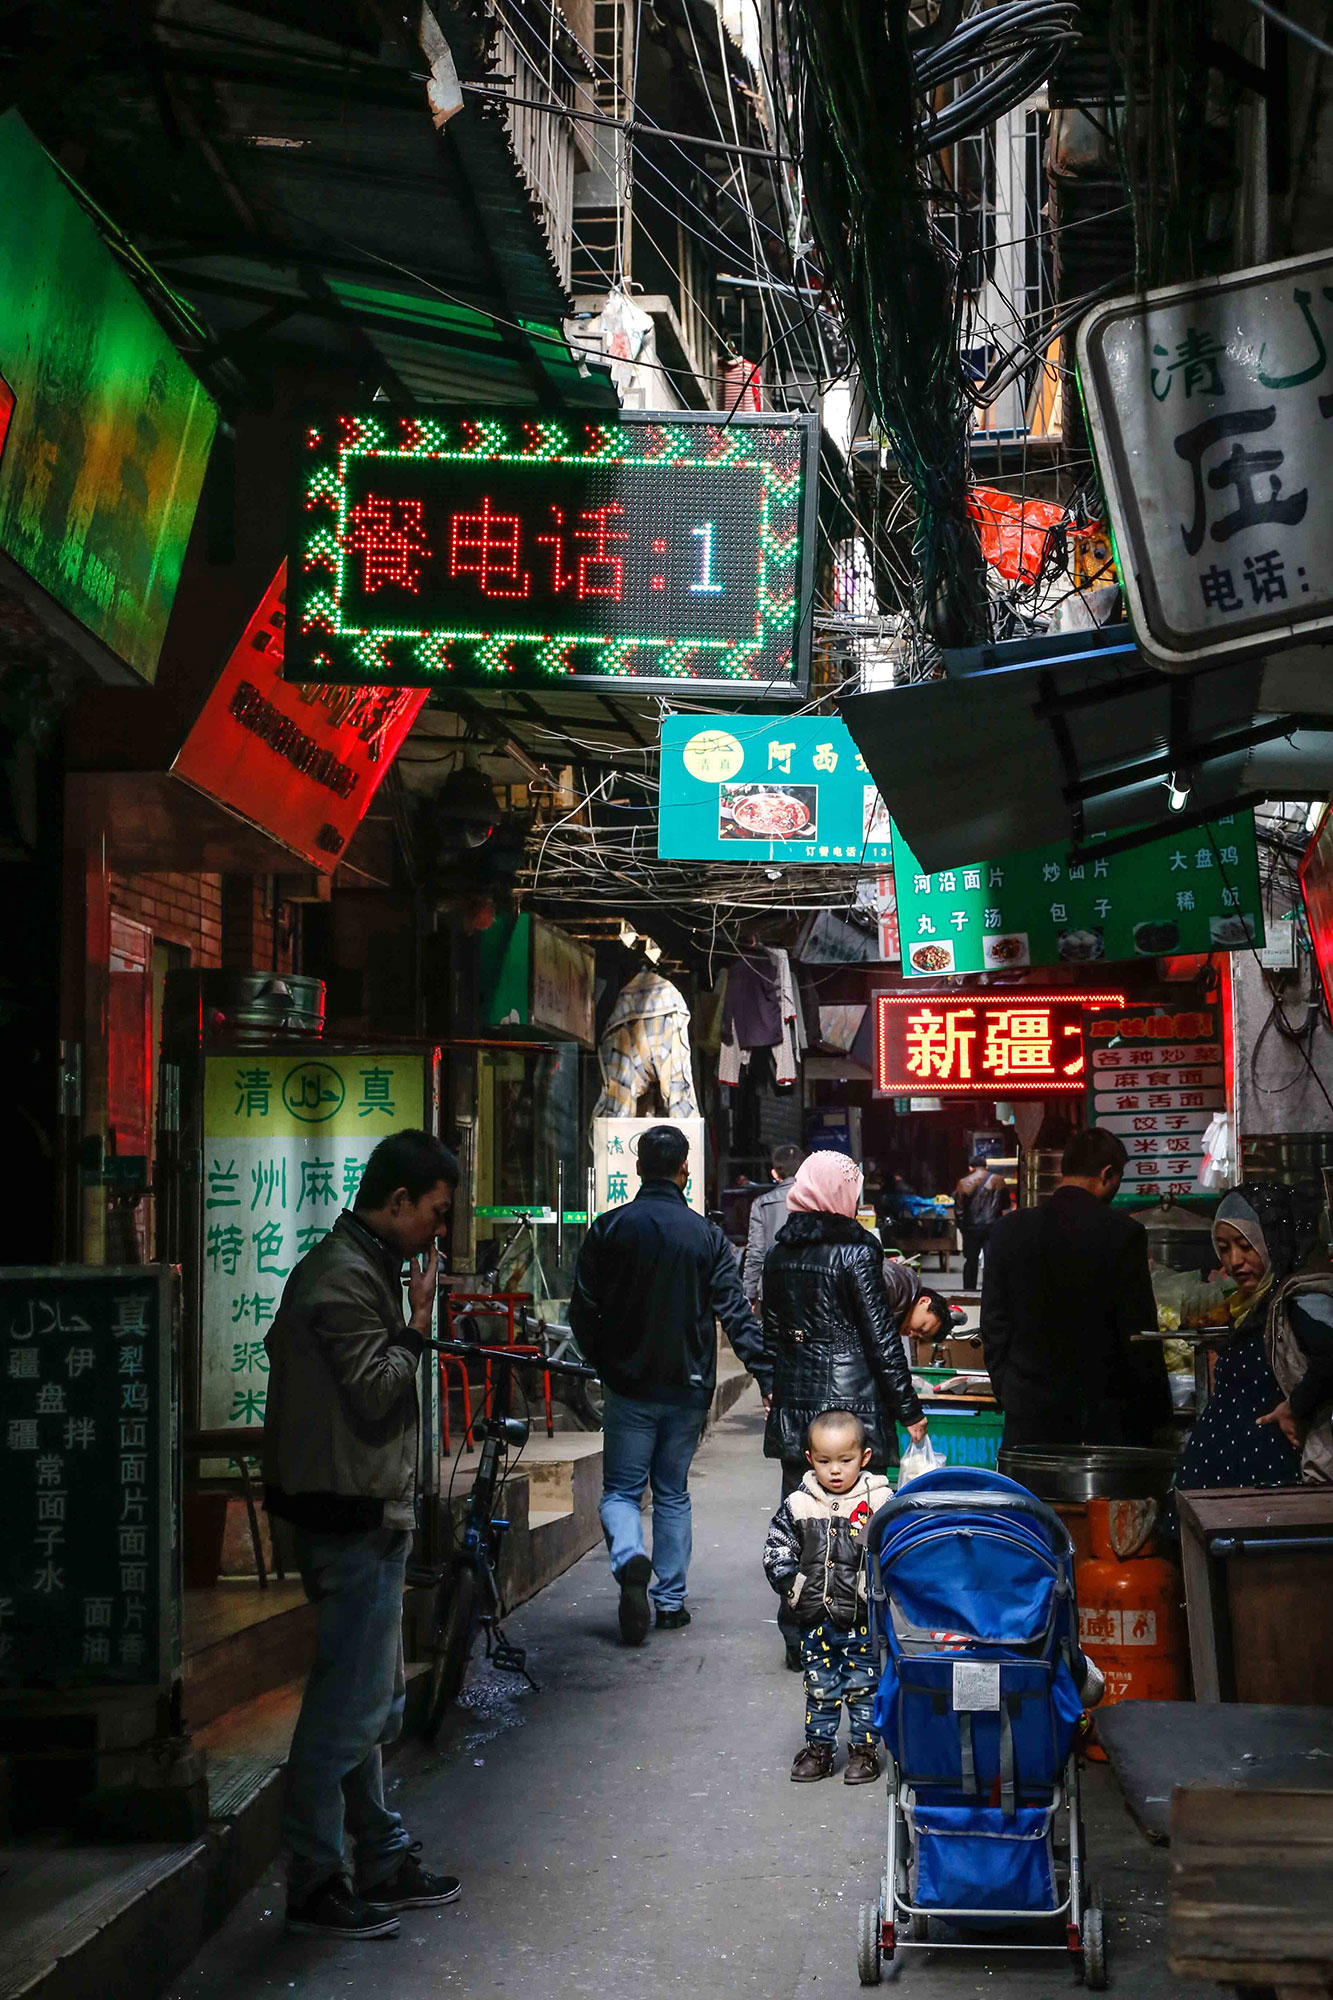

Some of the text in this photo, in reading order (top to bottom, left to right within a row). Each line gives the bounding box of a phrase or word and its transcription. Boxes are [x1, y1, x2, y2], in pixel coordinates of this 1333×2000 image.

[1151, 327, 1226, 402] 清
[1174, 405, 1333, 556] 压
[1169, 845, 1239, 871] 大盘鸡
[913, 866, 1005, 895] 河沿面片
[917, 907, 1003, 935] 丸子汤
[1049, 898, 1113, 923] 包子
[1097, 1047, 1219, 1066] 各种炒菜
[1114, 1070, 1203, 1087] 麻食面
[1116, 1092, 1205, 1110] 雀舌面
[1132, 1115, 1190, 1131] 饺子
[1133, 1137, 1191, 1153] 米饭
[1135, 1159, 1192, 1176] 包子
